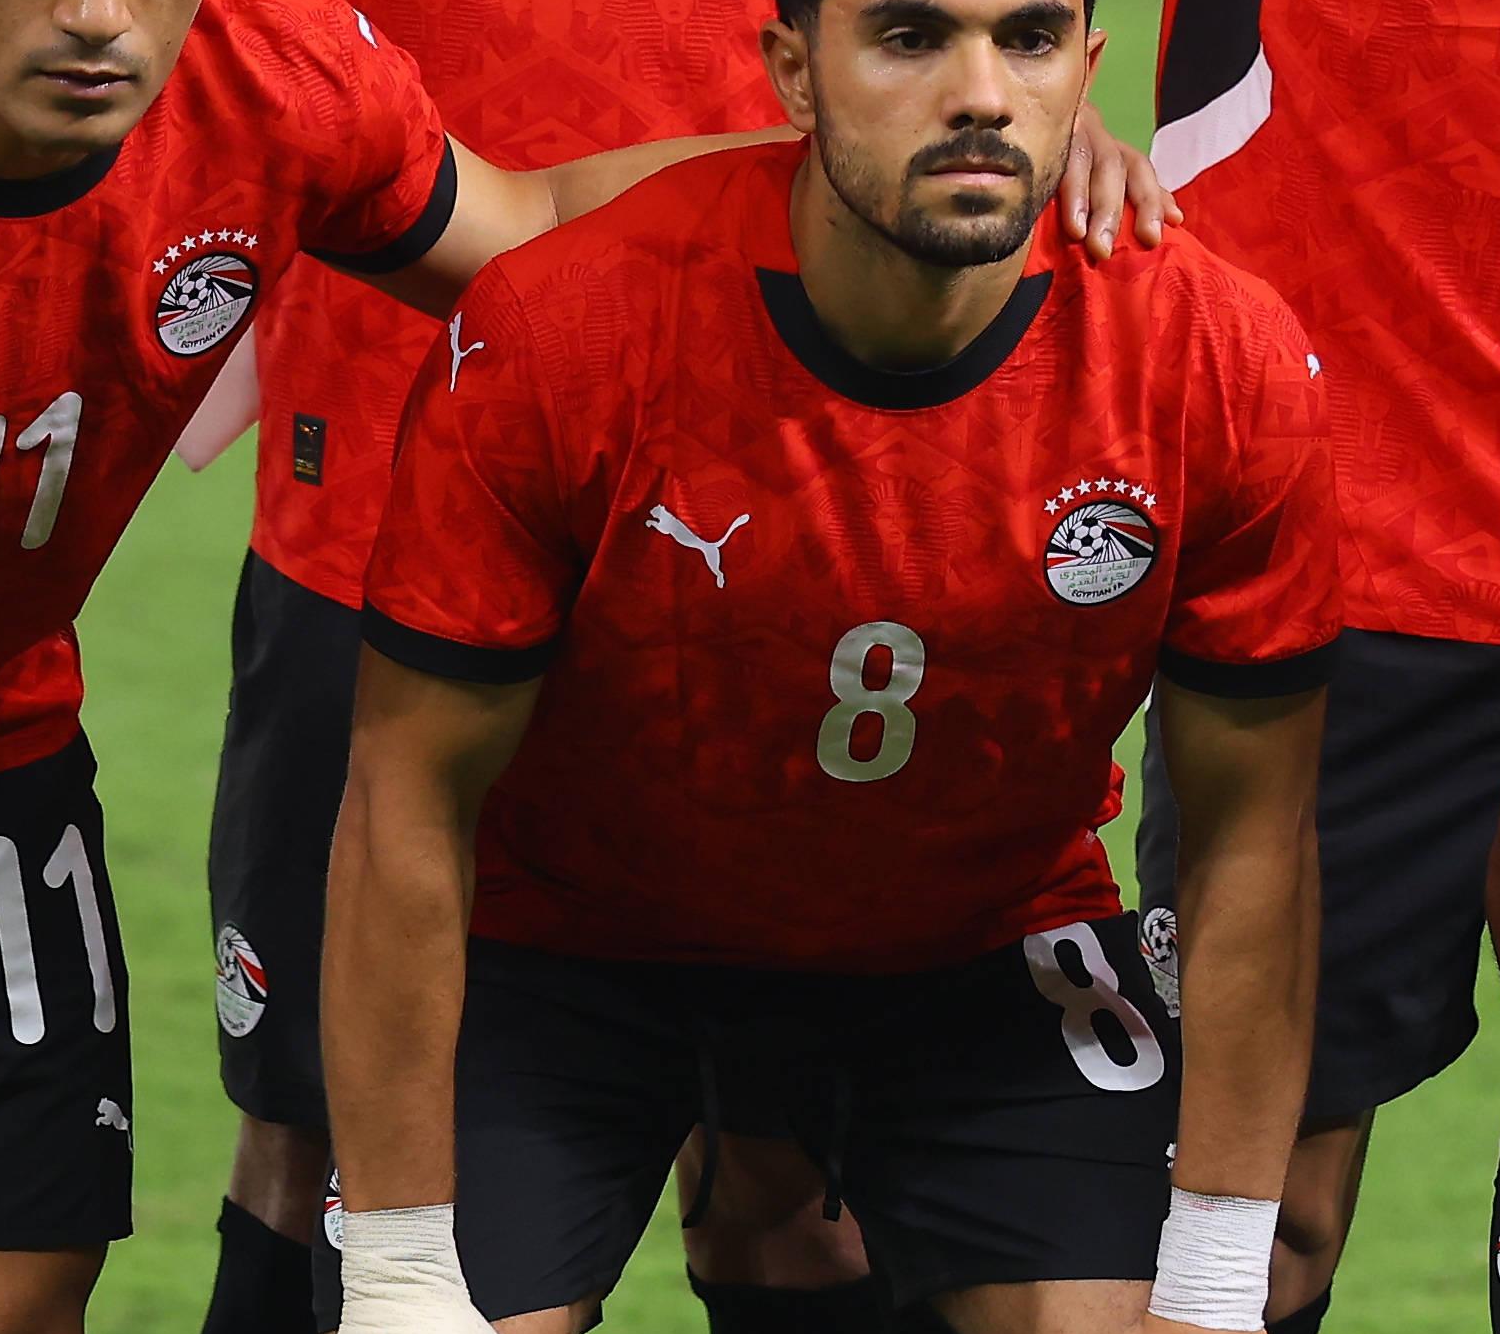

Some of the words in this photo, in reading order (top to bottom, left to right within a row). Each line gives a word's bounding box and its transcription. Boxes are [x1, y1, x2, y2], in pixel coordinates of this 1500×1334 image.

[1071, 588, 1112, 598] EGYPTIAN
[815, 620, 926, 783] 8
[1023, 922, 1166, 1092] 8
